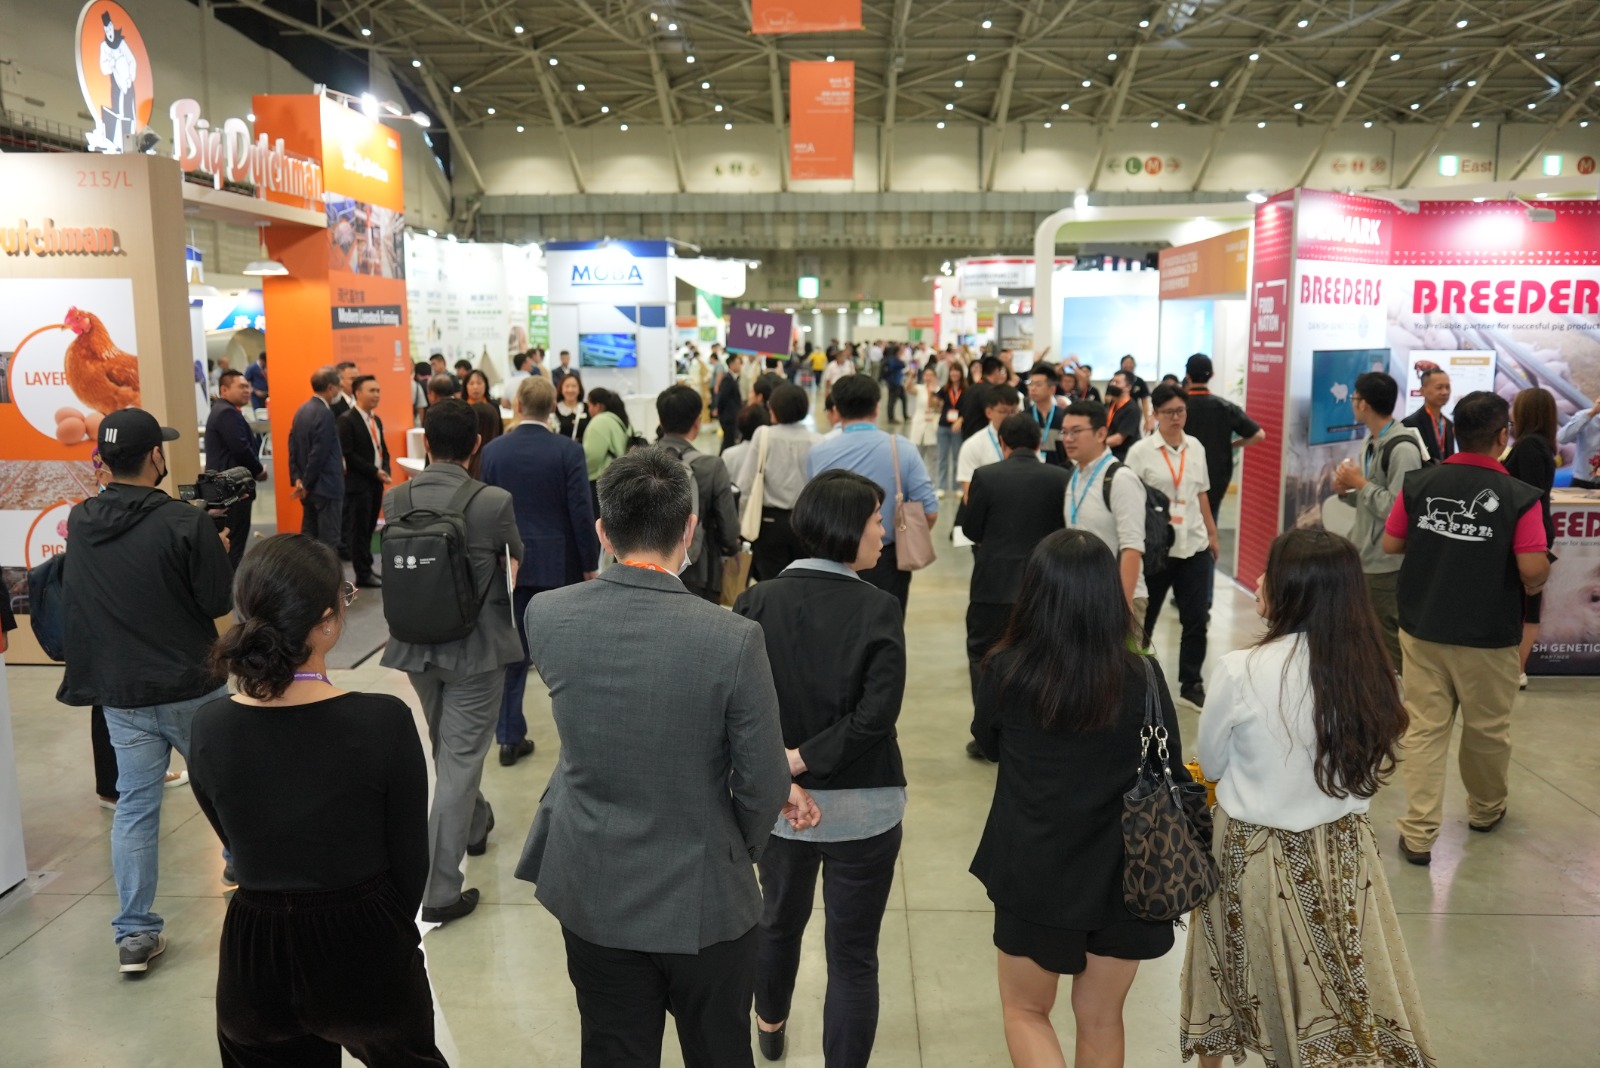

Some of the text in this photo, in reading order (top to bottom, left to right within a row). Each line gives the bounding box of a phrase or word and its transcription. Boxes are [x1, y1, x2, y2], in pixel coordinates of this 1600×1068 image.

[170, 98, 224, 191] Big
[224, 117, 325, 200] Dutchman
[1461, 159, 1493, 174] East
[77, 170, 133, 189] 215/L
[571, 264, 643, 282] MOBA
[1300, 274, 1382, 306] BREEDERS
[1412, 279, 1600, 314] BREEDER
[745, 322, 776, 339] VIP
[1497, 322, 1509, 330] for
[1512, 322, 1550, 330] succesful
[1551, 322, 1565, 332] pig
[25, 371, 69, 386] LAYER
[1550, 643, 1600, 653] GENETIC
